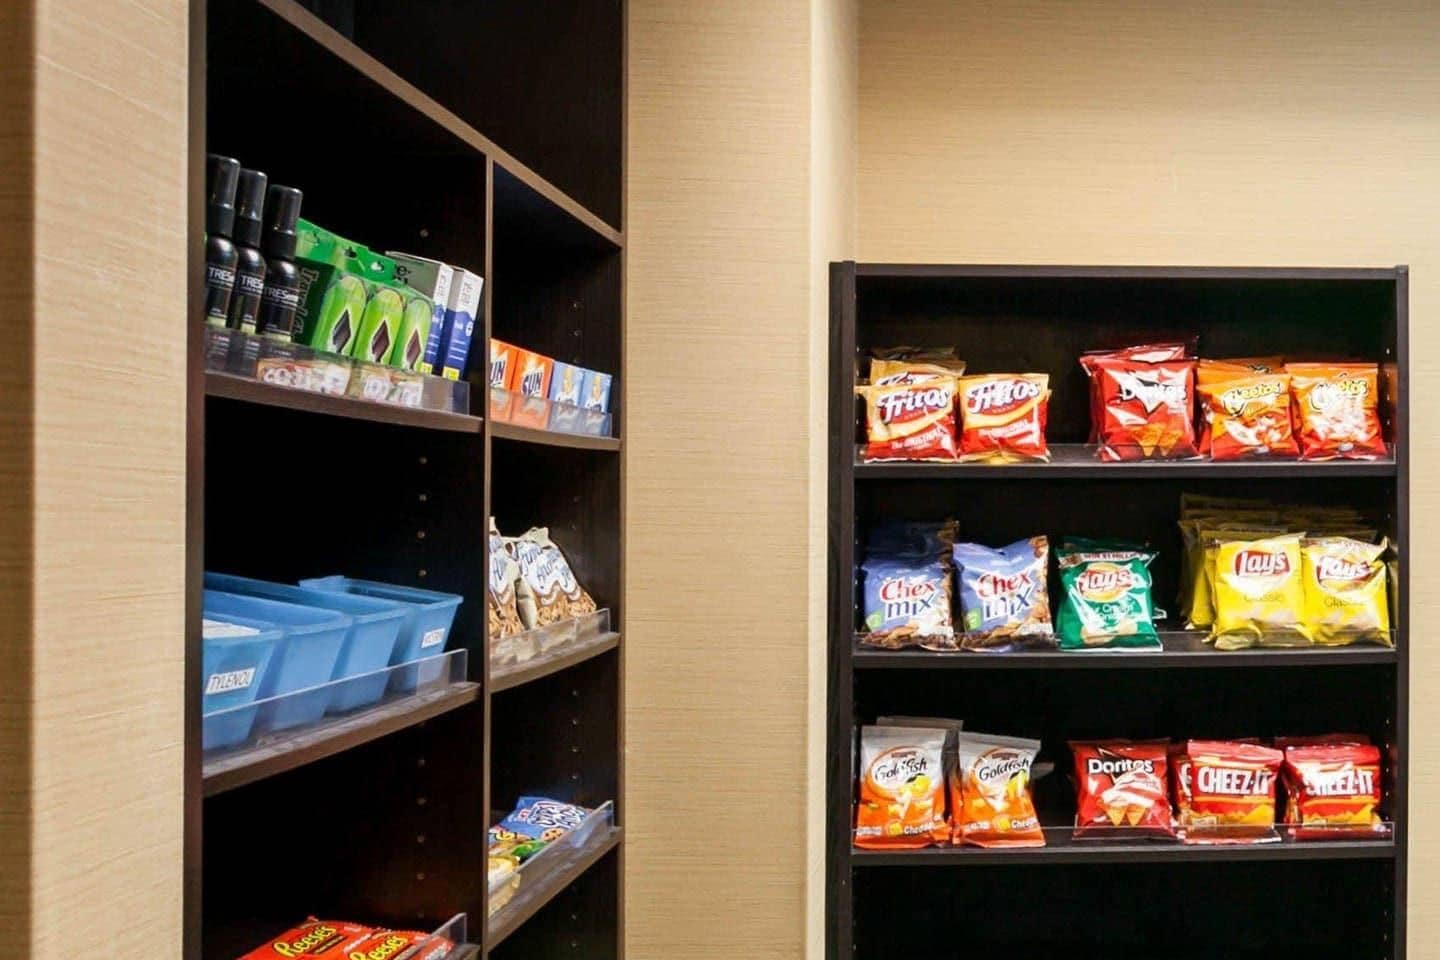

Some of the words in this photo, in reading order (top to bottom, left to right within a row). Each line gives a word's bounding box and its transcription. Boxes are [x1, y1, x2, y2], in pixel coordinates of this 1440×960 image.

[876, 388, 950, 425] Fritos
[967, 380, 1041, 414] Fritos
[881, 576, 936, 601] Chex
[977, 572, 1031, 598] Chex
[978, 758, 1031, 782] Goldfish
[1088, 757, 1154, 775] Doritos
[274, 924, 337, 958] Reese's
